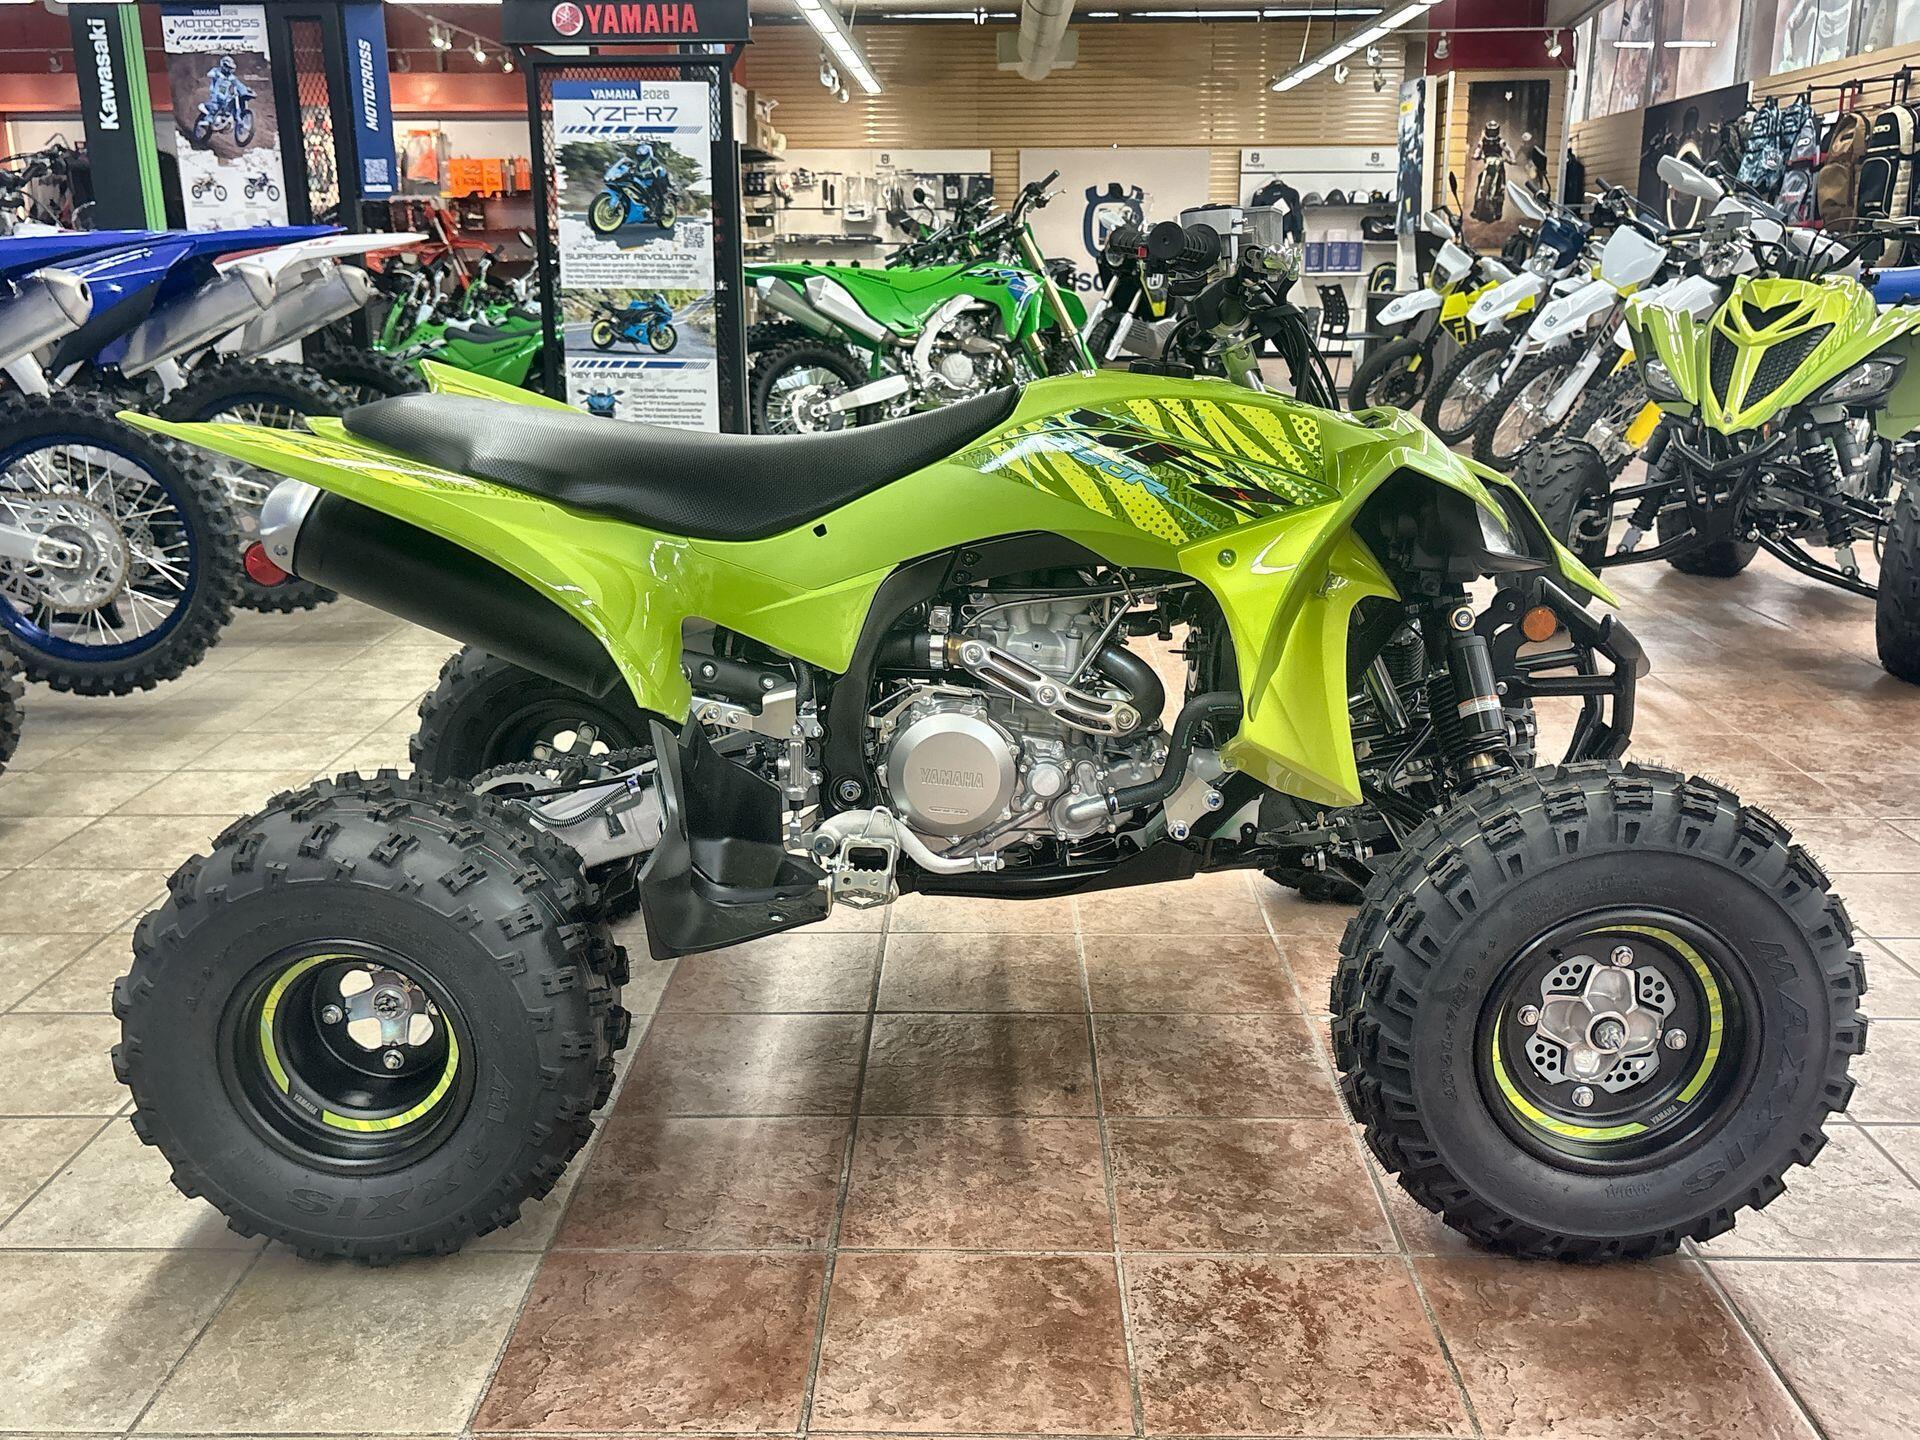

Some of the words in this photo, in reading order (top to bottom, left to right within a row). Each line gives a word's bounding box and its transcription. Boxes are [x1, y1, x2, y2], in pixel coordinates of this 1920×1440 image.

[173, 19, 260, 28] MOTOCROSS
[584, 4, 699, 34] YAMAHA
[87, 19, 119, 130] Kawasaki
[358, 38, 380, 132] MOTOCROSS
[591, 89, 639, 100] YAMAHA
[643, 89, 670, 100] 2026
[584, 106, 679, 122] YZF-R7
[565, 253, 631, 261] SUPERSPORT
[634, 253, 697, 261] REVOLUTION
[571, 371, 590, 379] KEY
[593, 371, 644, 379] FEATURES
[920, 767, 984, 789] YAMAHA
[1682, 938, 1809, 1195] MAXXIS
[292, 1093, 320, 1116] YAMAHA
[1650, 1104, 1678, 1125] YAMAHA
